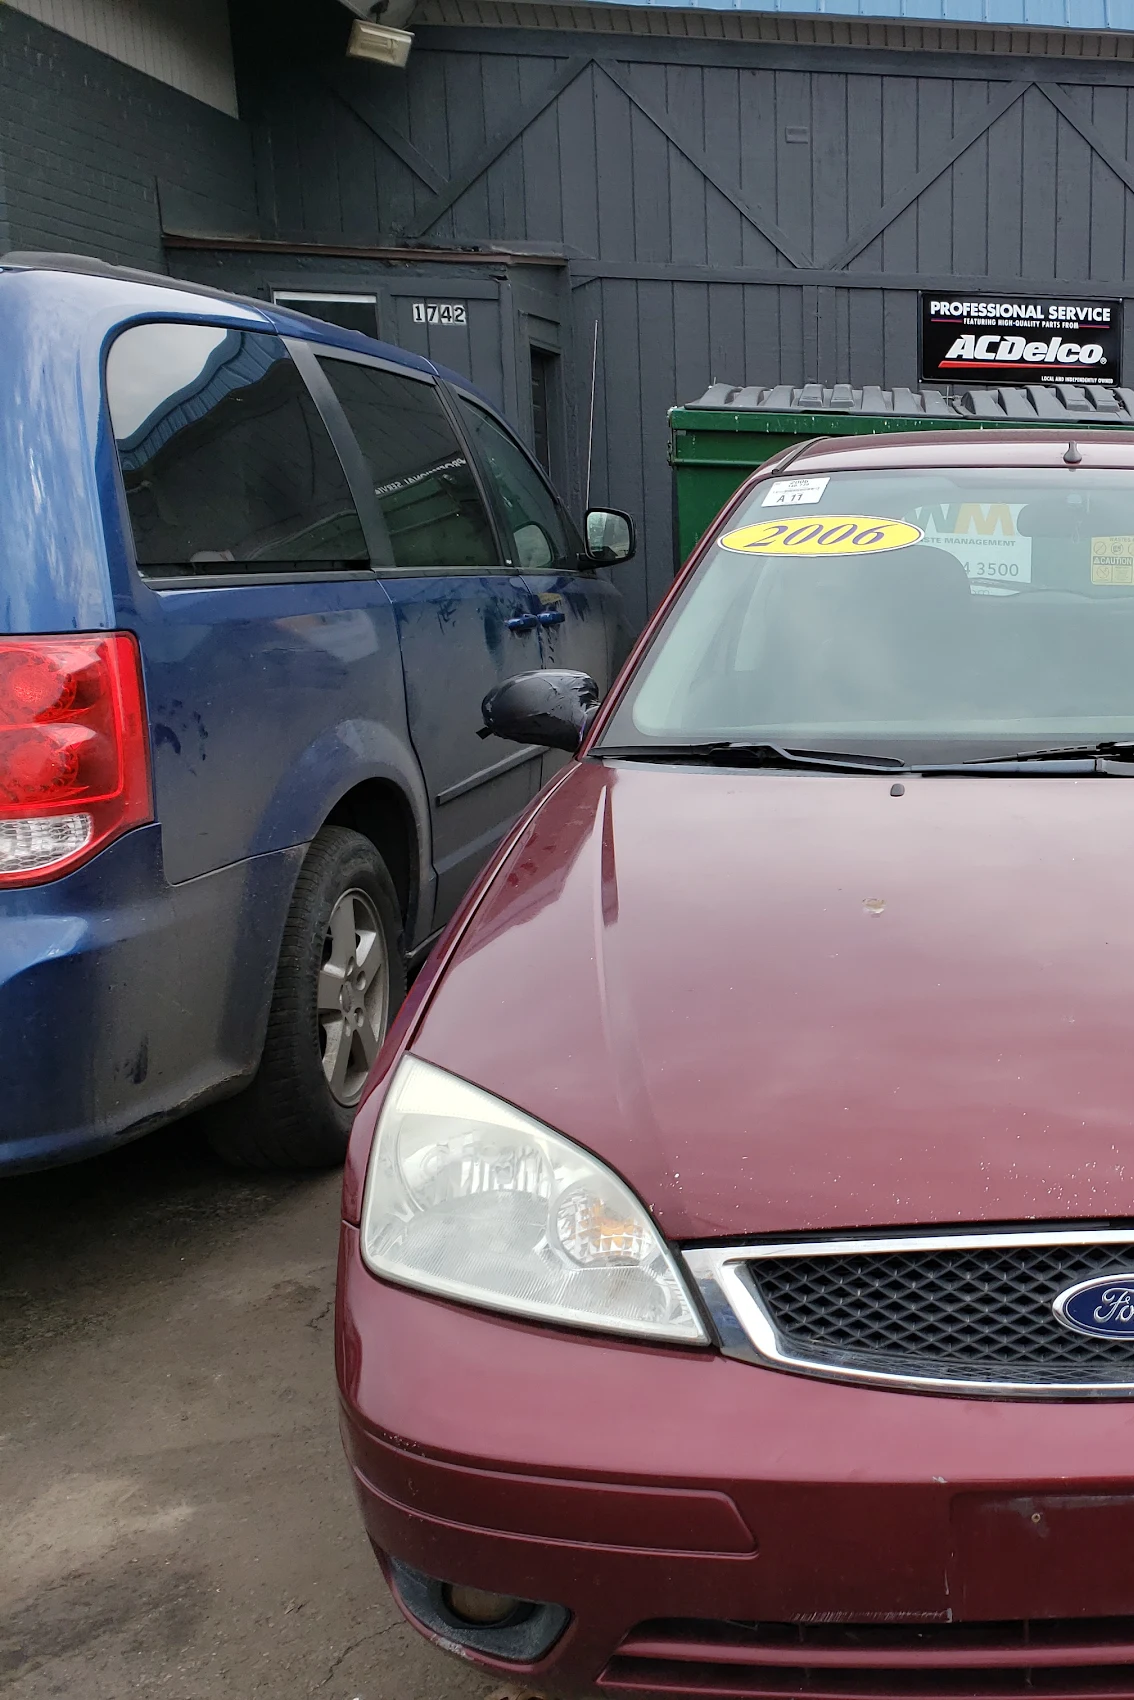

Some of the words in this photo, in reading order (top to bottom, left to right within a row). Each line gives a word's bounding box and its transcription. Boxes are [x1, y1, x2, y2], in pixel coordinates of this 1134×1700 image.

[414, 304, 465, 323] 1742
[930, 301, 1045, 319] PROFESSIONAL
[1048, 306, 1111, 322] SERVICE
[963, 317, 996, 326] FEATURING
[997, 319, 1040, 328] HIGH-QUALITY
[1041, 320, 1060, 328] PARTS
[1062, 321, 1079, 329] FROM
[945, 334, 1104, 364] ACDelco
[1041, 375, 1055, 383] LOCAL
[743, 523, 899, 548] 2006
[944, 538, 1016, 547] MANAGEMENT
[1100, 557, 1132, 565] CAUTION
[976, 562, 1019, 577] 3500
